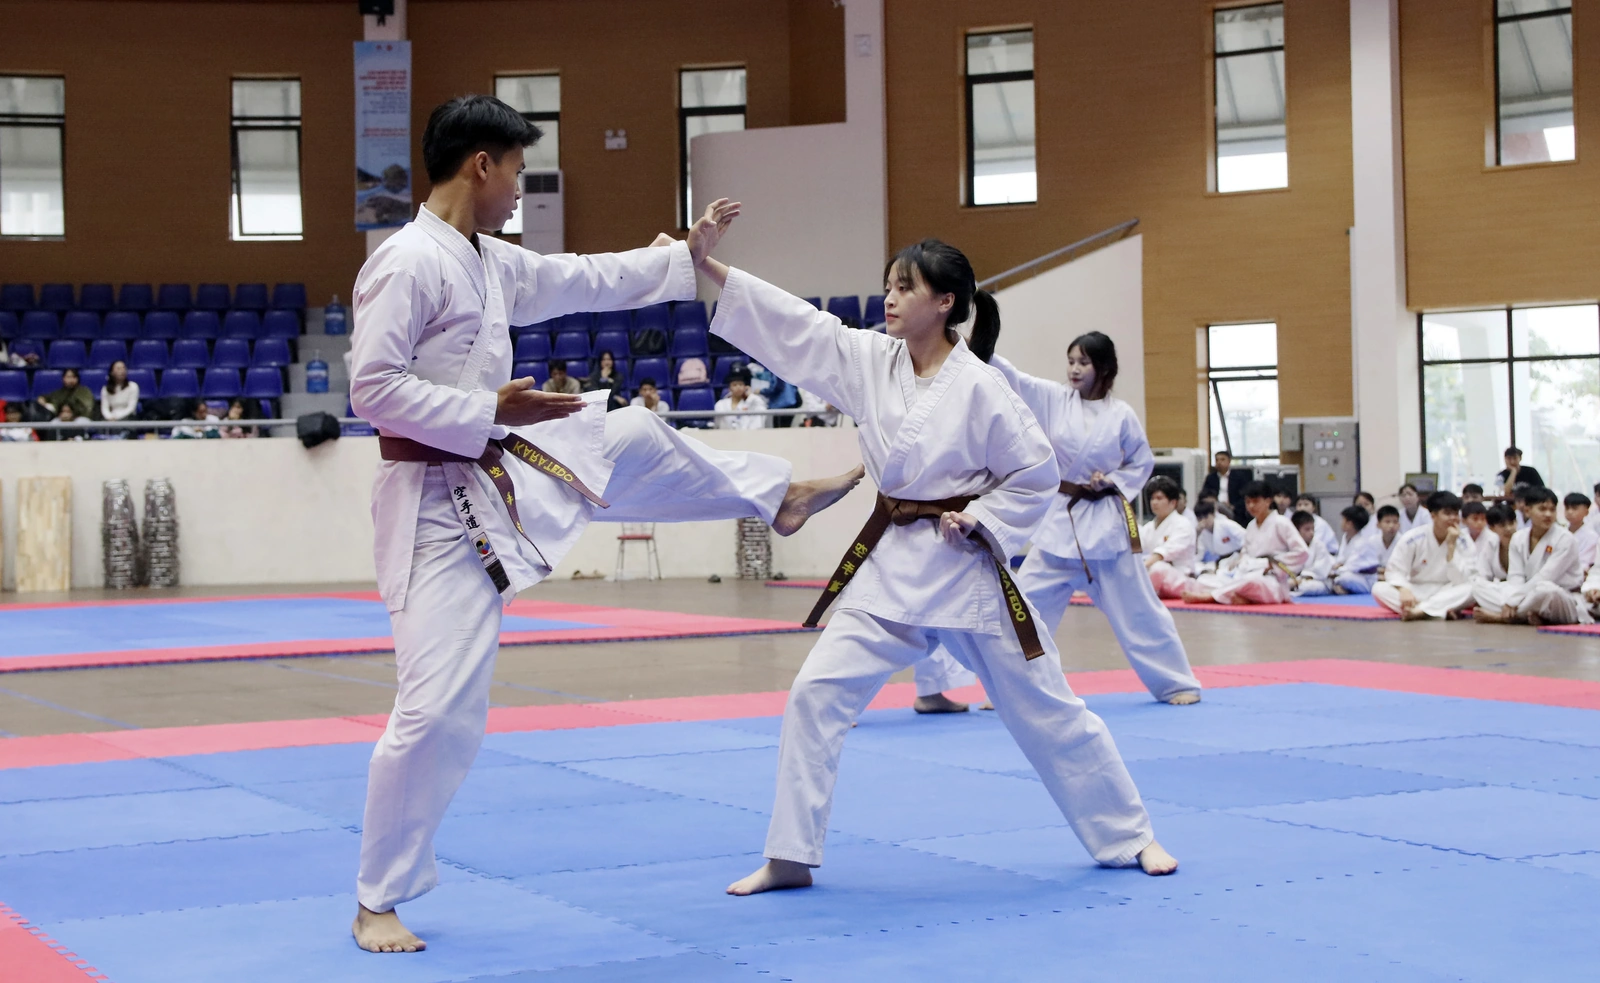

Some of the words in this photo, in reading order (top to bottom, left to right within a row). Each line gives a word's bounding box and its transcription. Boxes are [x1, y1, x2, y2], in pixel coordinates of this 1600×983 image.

[453, 486, 481, 530] 空手道
[489, 466, 525, 534] 空手
[996, 562, 1027, 622] ARATEDO
